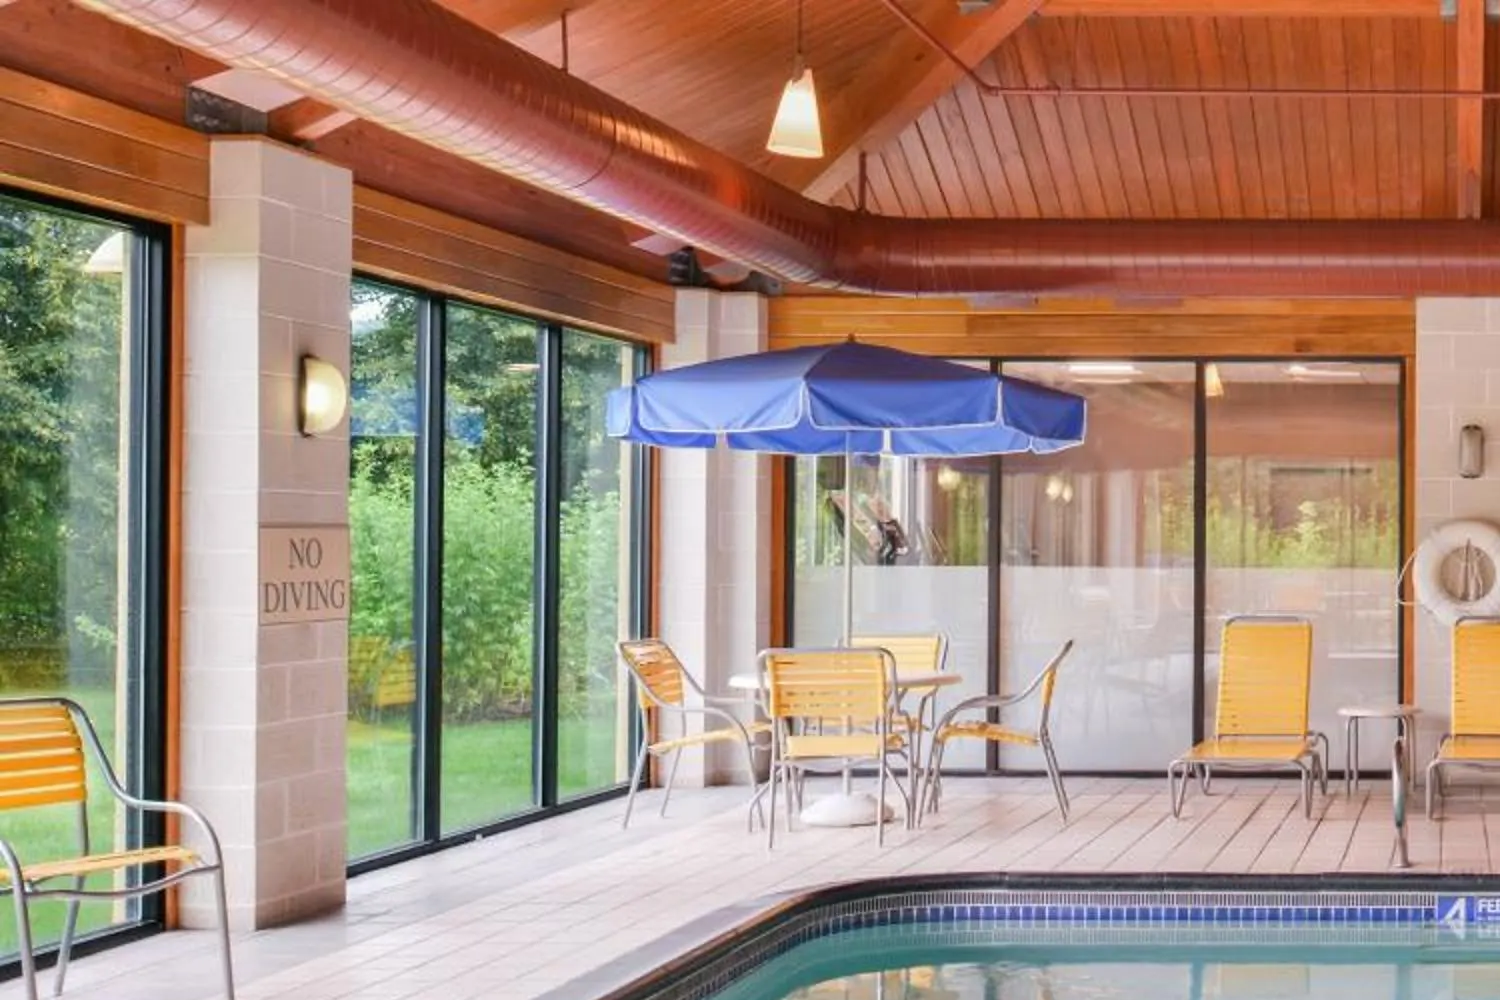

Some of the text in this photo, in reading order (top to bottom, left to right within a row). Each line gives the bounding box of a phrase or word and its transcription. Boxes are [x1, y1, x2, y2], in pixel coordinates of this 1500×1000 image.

[288, 537, 323, 570] NO
[263, 579, 346, 613] DIVING
[1443, 897, 1467, 923] 4
